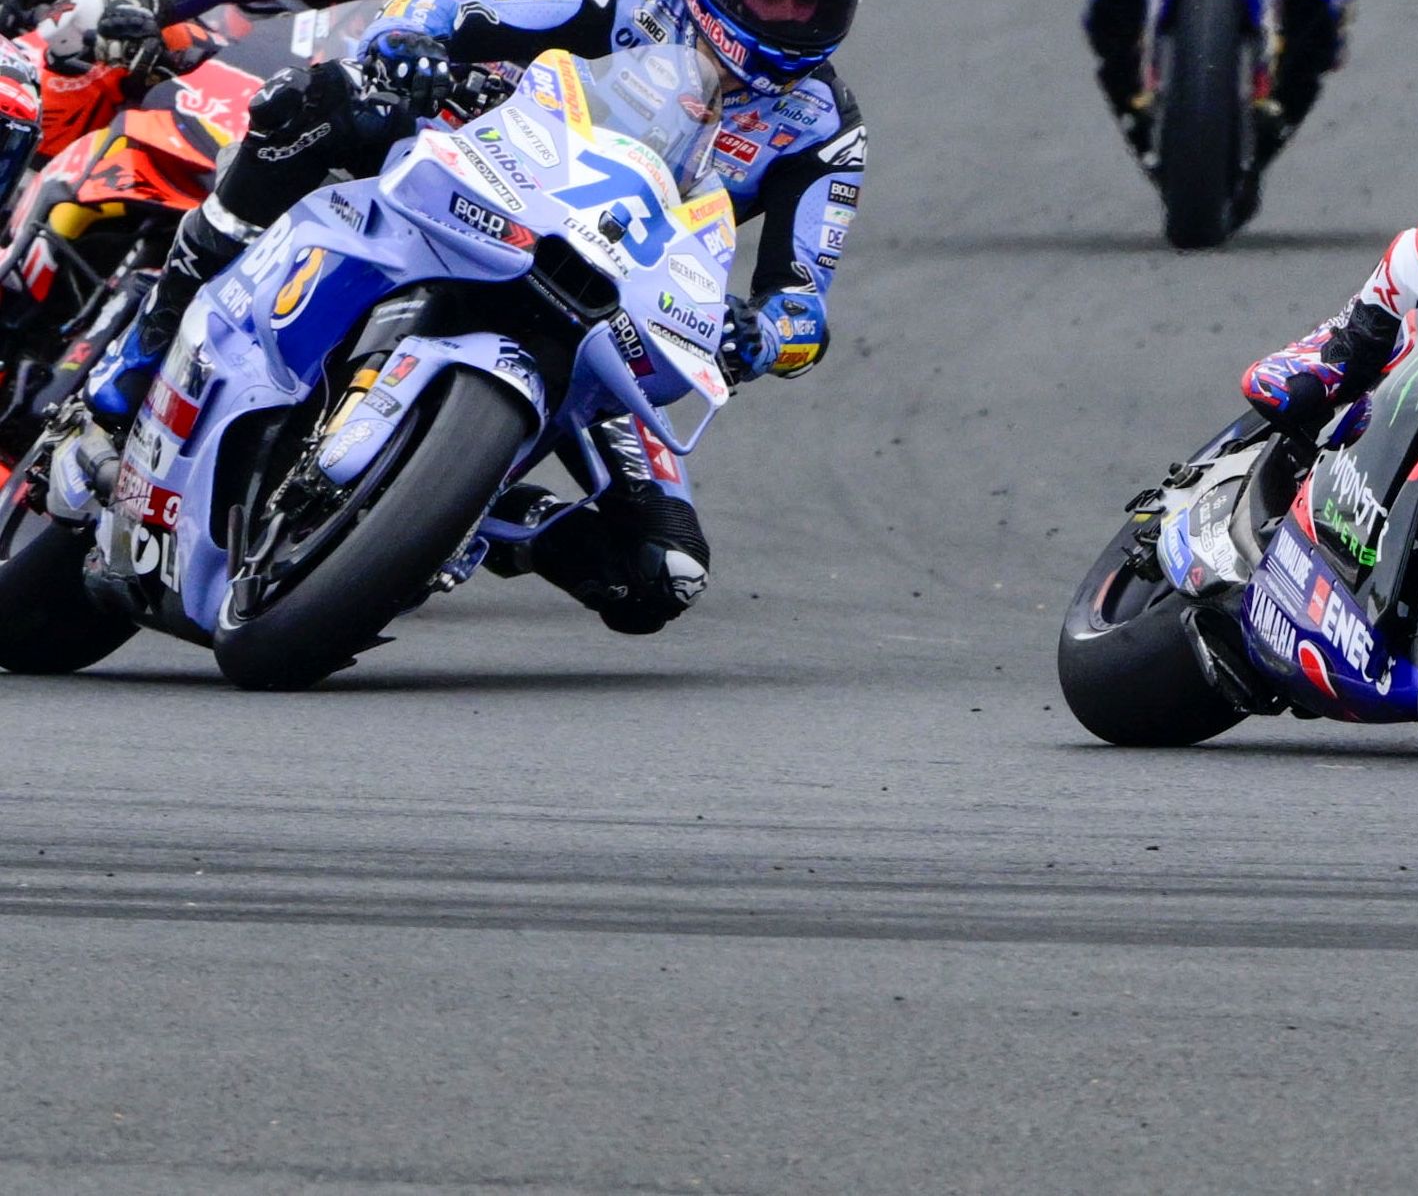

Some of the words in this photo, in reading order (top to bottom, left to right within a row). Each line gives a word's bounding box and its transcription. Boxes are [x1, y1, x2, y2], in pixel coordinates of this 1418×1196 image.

[636, 12, 667, 43] SHOEI
[772, 99, 818, 126] Unibat
[475, 126, 537, 192] Unibat
[331, 190, 365, 235] DUCATI
[454, 197, 504, 233] BOLD
[550, 148, 677, 268] 73
[563, 217, 630, 277] Gigetta
[217, 277, 253, 319] NEWS
[658, 291, 715, 339] Unibat
[614, 312, 645, 358] BOLD
[1329, 443, 1389, 562] MONST
[1323, 498, 1377, 567] ENERG
[1248, 582, 1297, 662] YAMAHA
